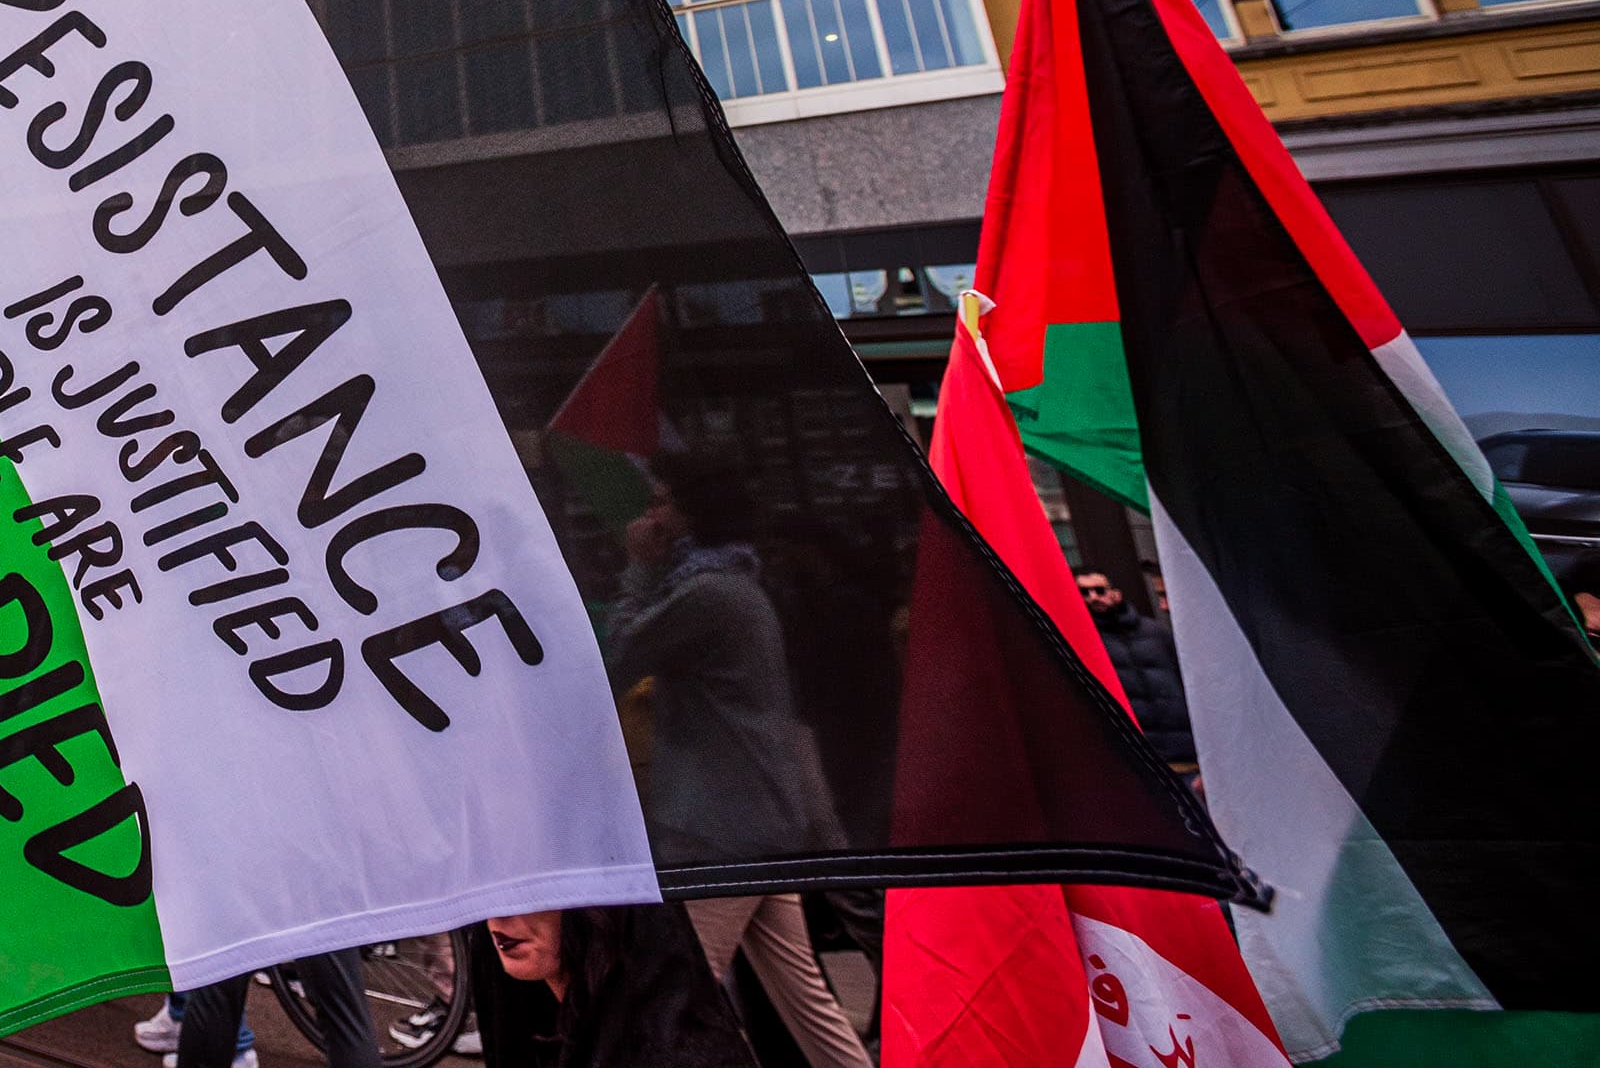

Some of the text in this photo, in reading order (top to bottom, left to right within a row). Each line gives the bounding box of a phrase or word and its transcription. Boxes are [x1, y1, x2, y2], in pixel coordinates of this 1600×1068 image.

[3, 275, 345, 712] IS JUSTIFIED
[12, 494, 143, 621] ARE
